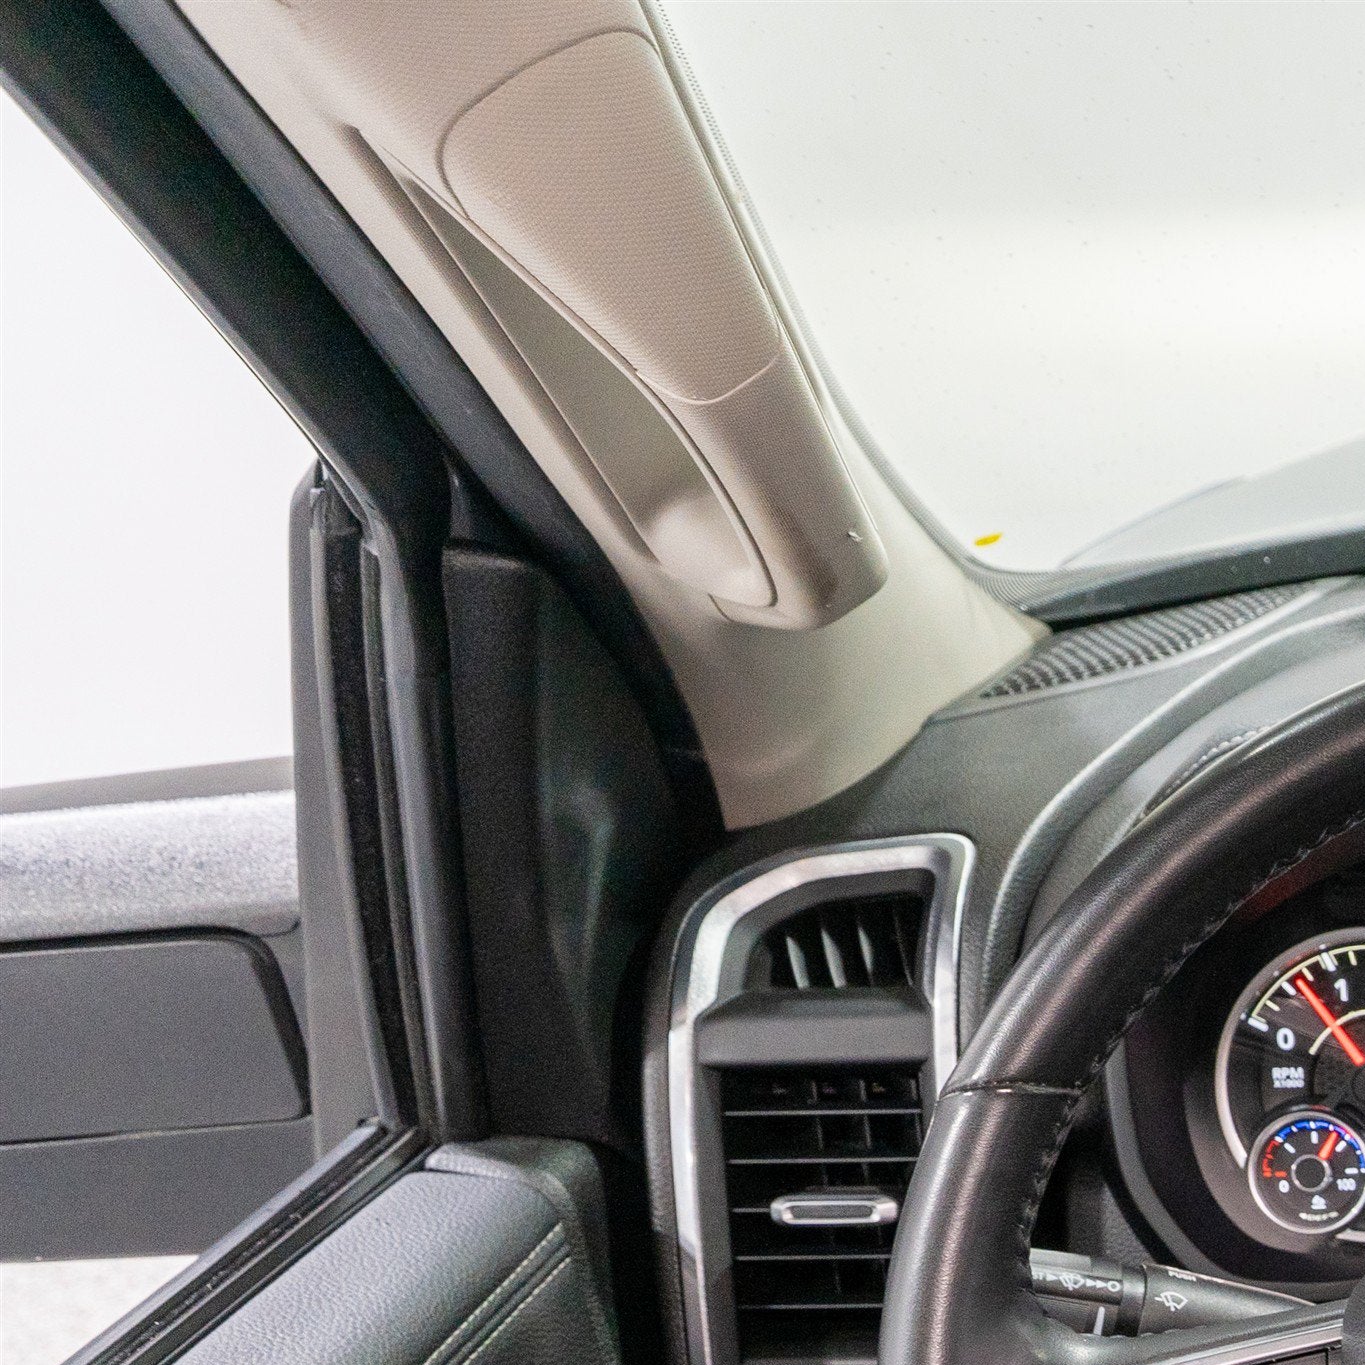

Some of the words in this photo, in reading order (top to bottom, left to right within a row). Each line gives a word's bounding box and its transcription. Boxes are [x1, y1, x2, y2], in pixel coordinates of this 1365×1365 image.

[1333, 979, 1349, 1002] 1
[1275, 1028, 1295, 1051] 0
[1271, 1066, 1305, 1080] RPM
[1278, 1179, 1290, 1193] 0
[1336, 1178, 1357, 1191] 100
